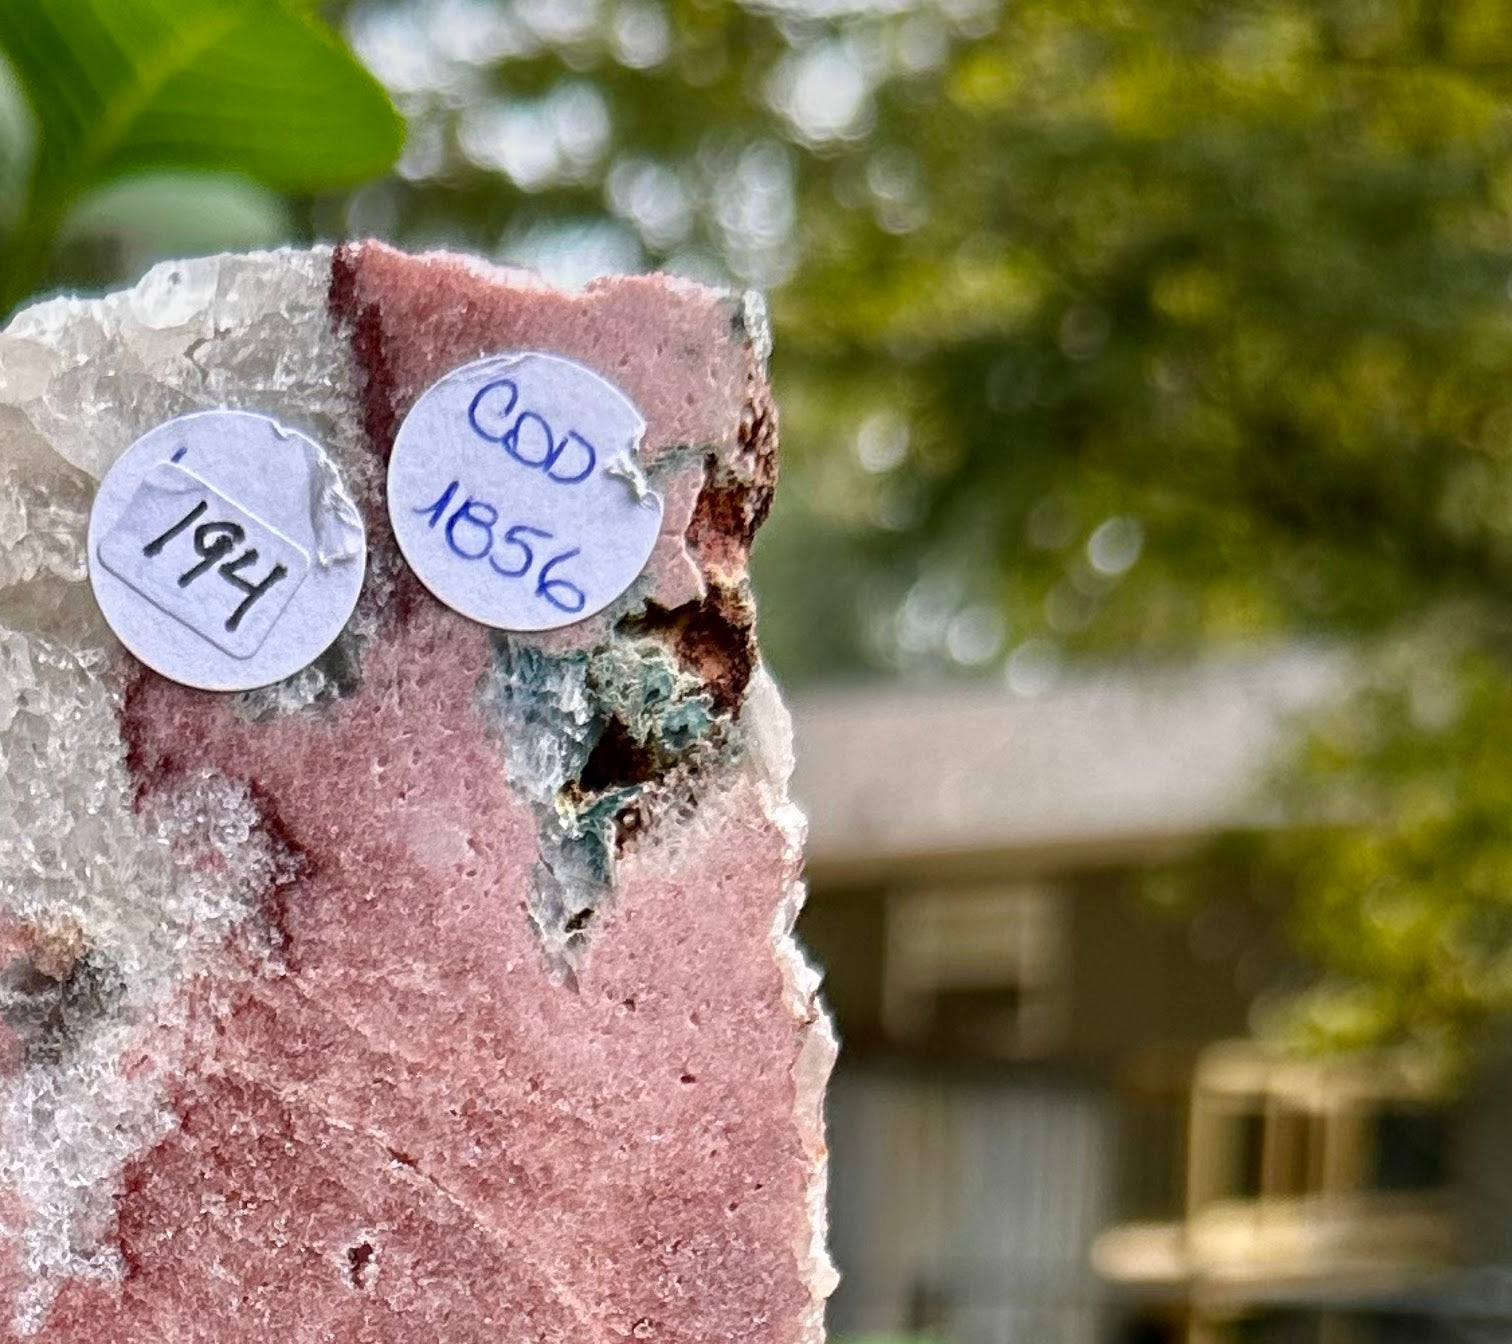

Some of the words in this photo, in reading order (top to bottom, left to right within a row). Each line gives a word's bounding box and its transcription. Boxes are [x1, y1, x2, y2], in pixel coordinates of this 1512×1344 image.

[468, 379, 596, 484] COD
[143, 500, 287, 632] 194
[412, 480, 586, 613] 1856
